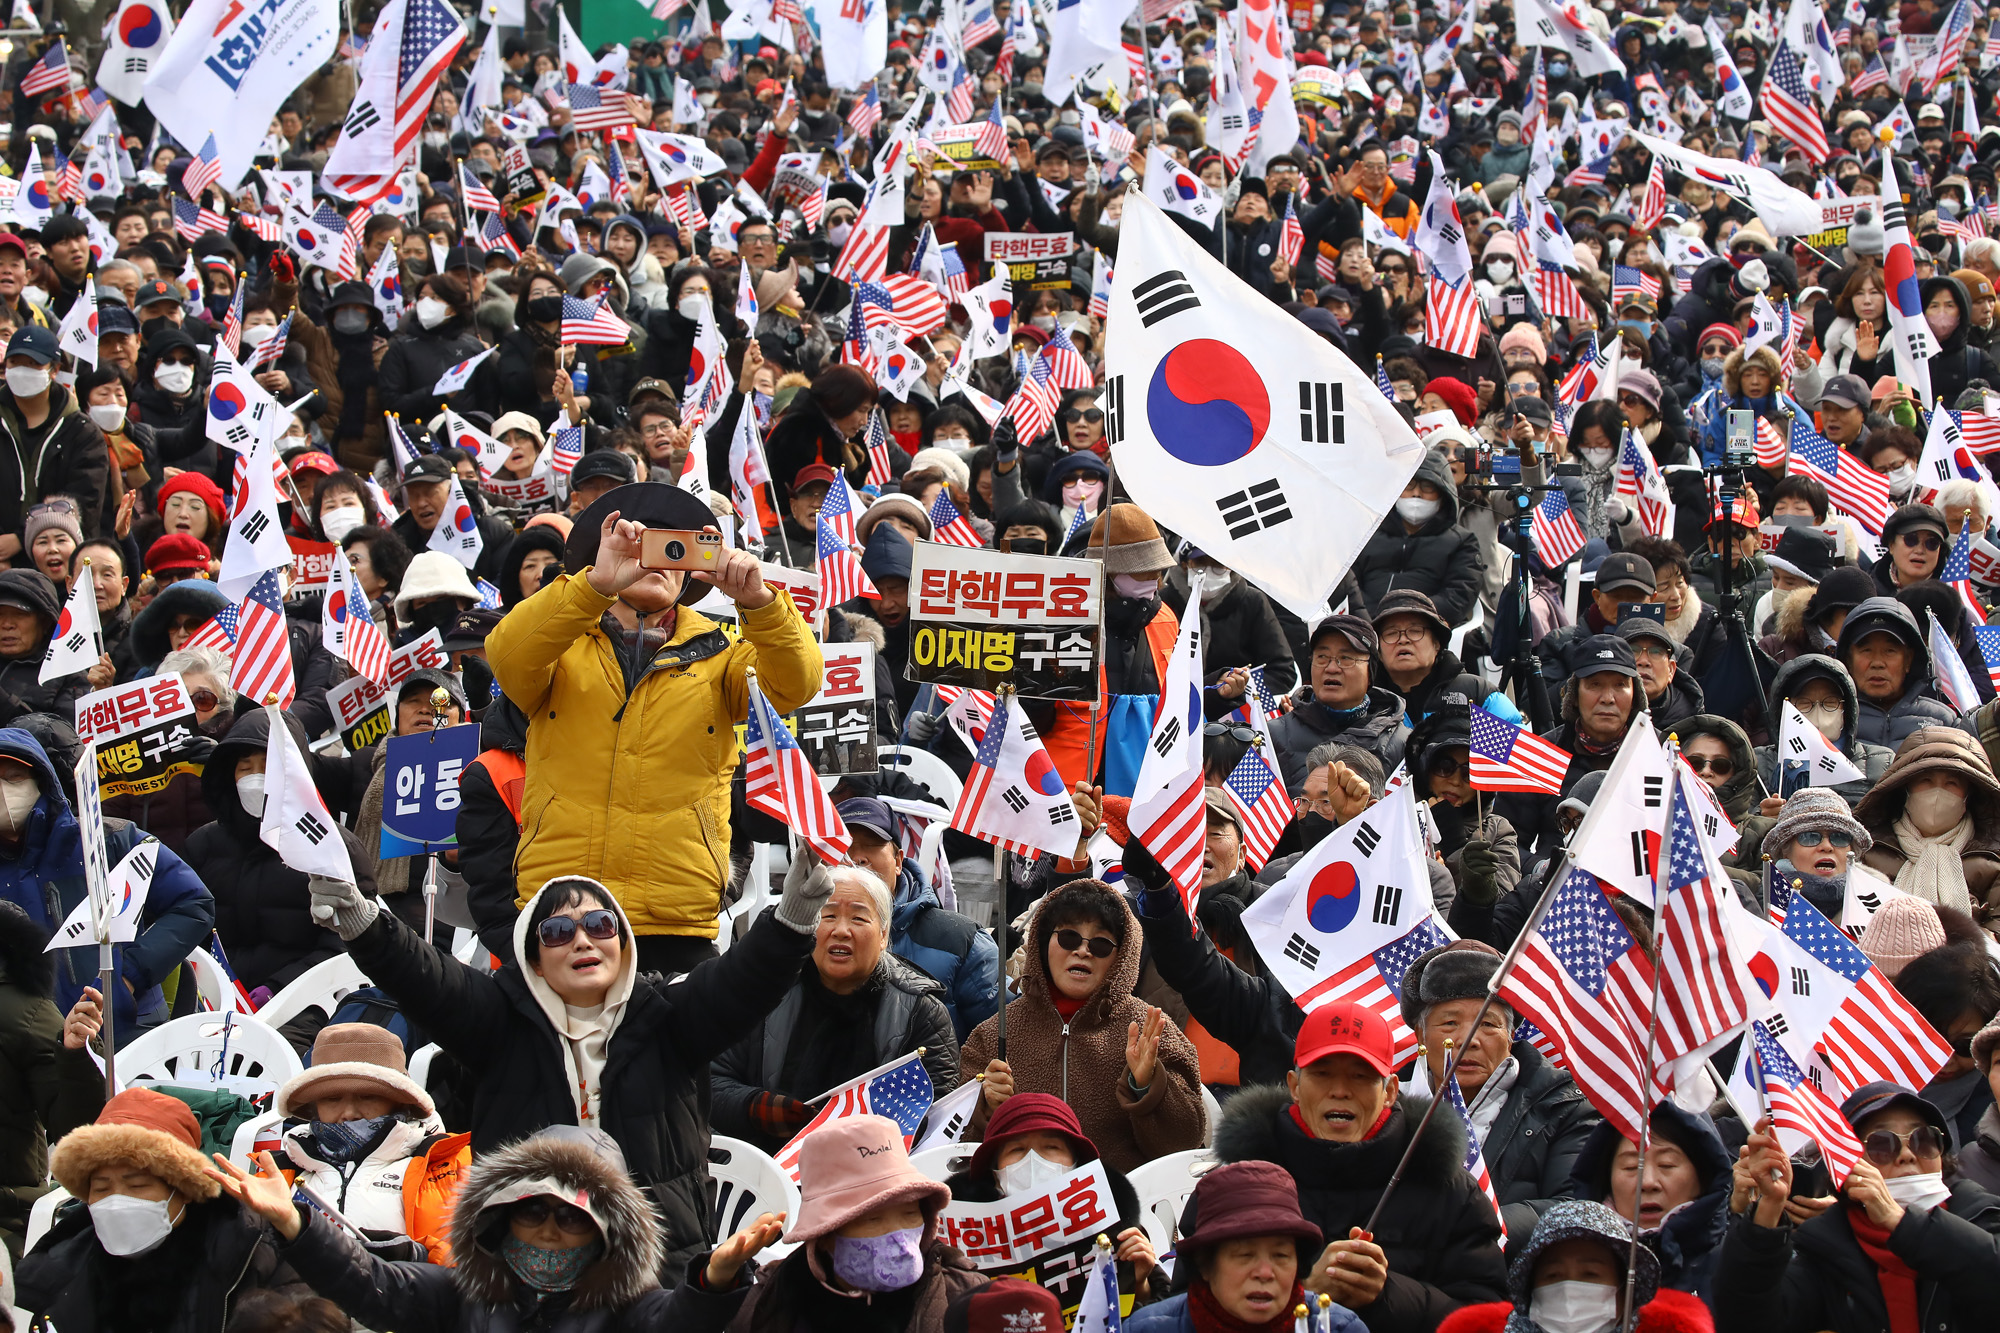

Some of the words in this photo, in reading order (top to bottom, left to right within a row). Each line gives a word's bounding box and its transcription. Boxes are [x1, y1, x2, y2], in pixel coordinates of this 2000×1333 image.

[990, 236, 1069, 260] 탄핵무효
[1037, 259, 1068, 279] 구속
[920, 568, 1091, 619] 탄핵무효
[914, 628, 1016, 673] 이재명
[1019, 632, 1094, 672] 구속
[77, 678, 186, 745] 탄핵무효
[803, 708, 871, 750] 구속
[150, 765, 182, 789] STEAL
[857, 1139, 892, 1158] Daniel
